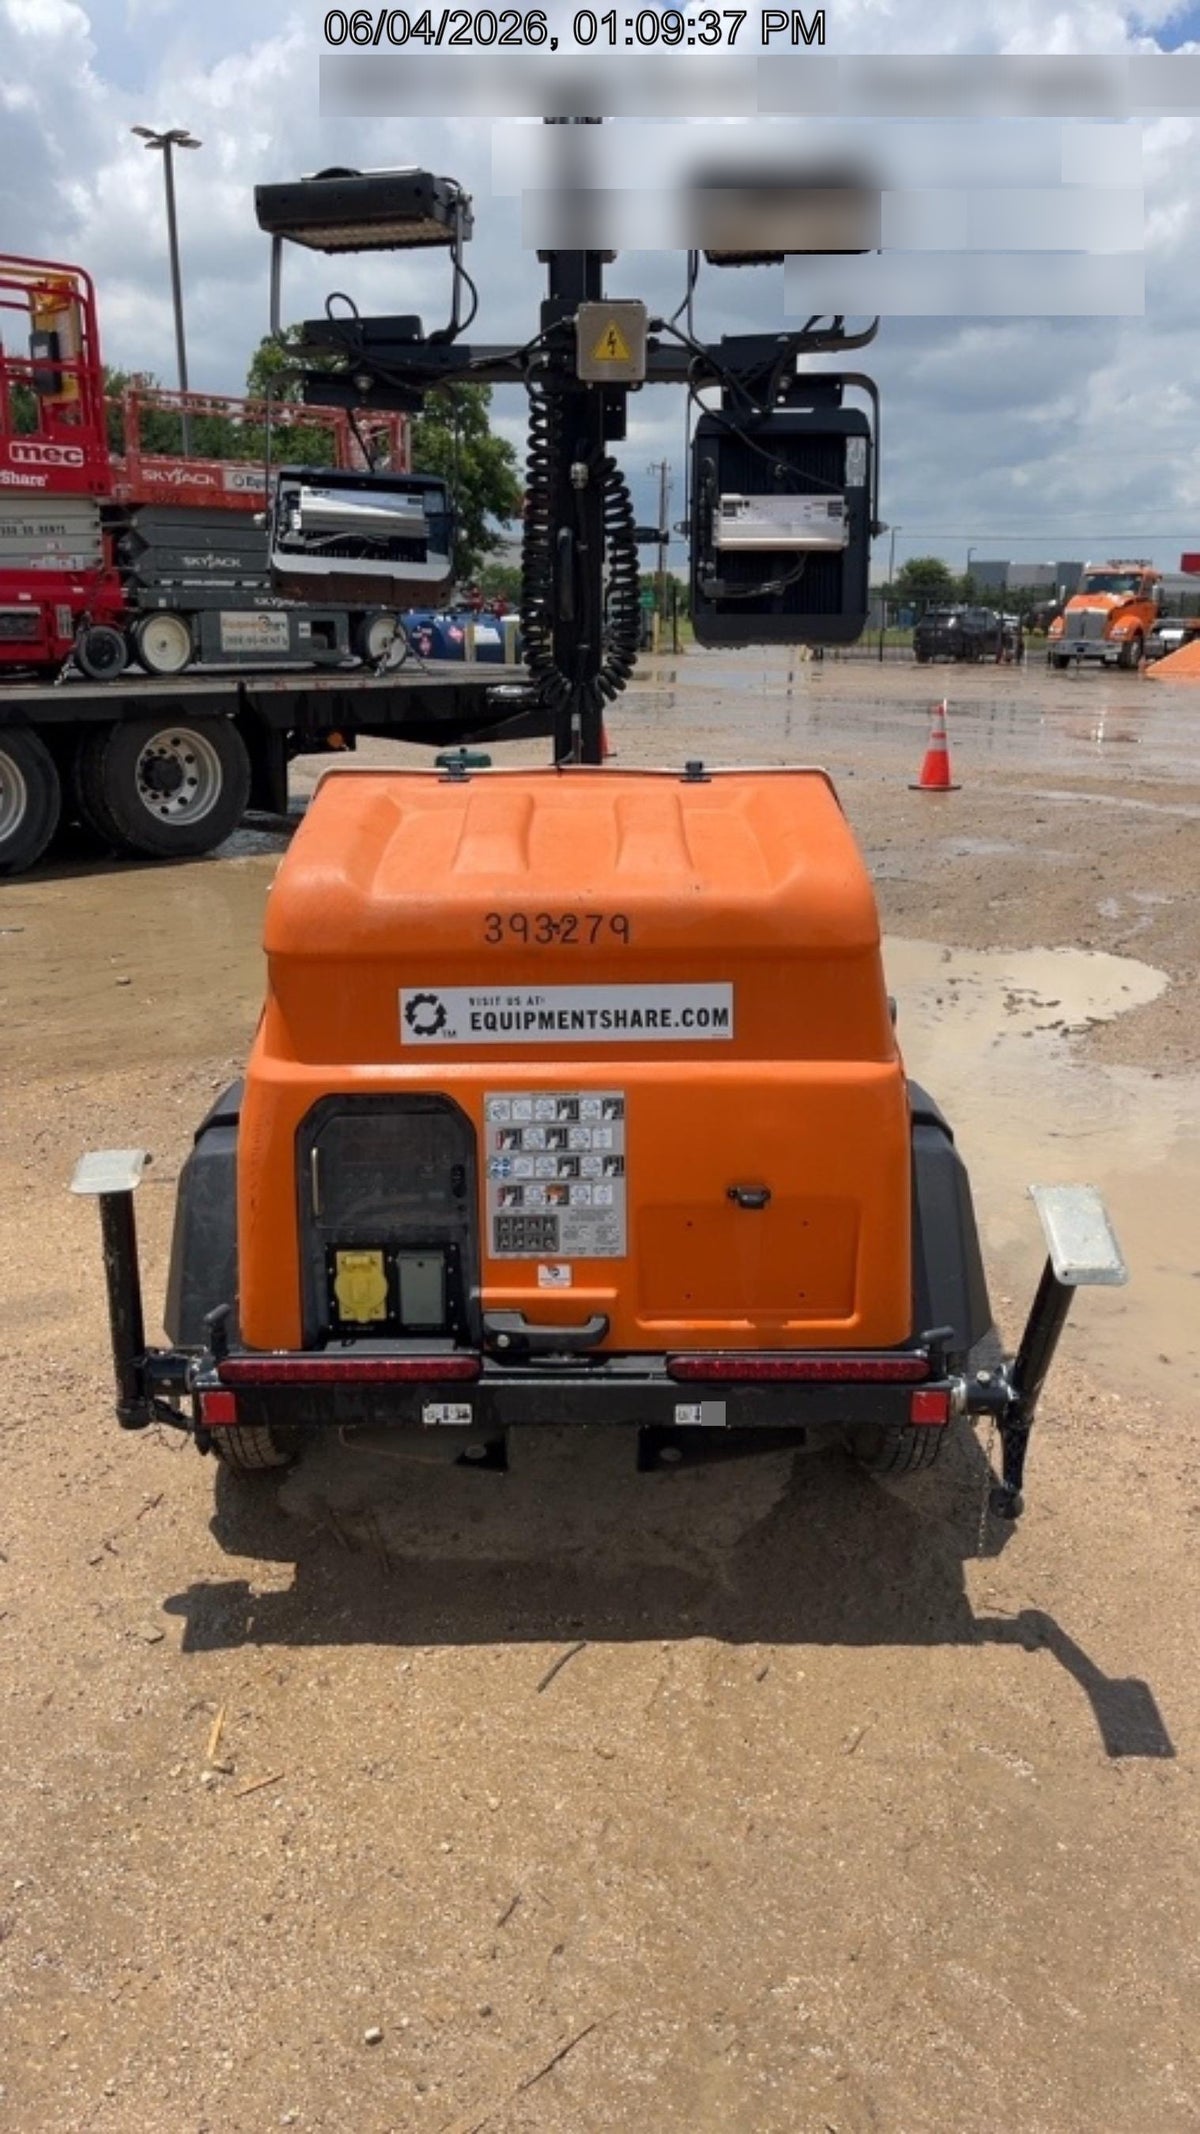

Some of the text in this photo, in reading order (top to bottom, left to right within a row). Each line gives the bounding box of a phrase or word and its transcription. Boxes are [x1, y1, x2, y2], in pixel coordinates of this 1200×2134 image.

[12, 446, 82, 463] mec
[142, 468, 216, 485] SKYJACK
[484, 912, 630, 944] 393279
[506, 996, 520, 1006] US
[471, 1008, 729, 1031] EQUIPMENTSHARE.COM
